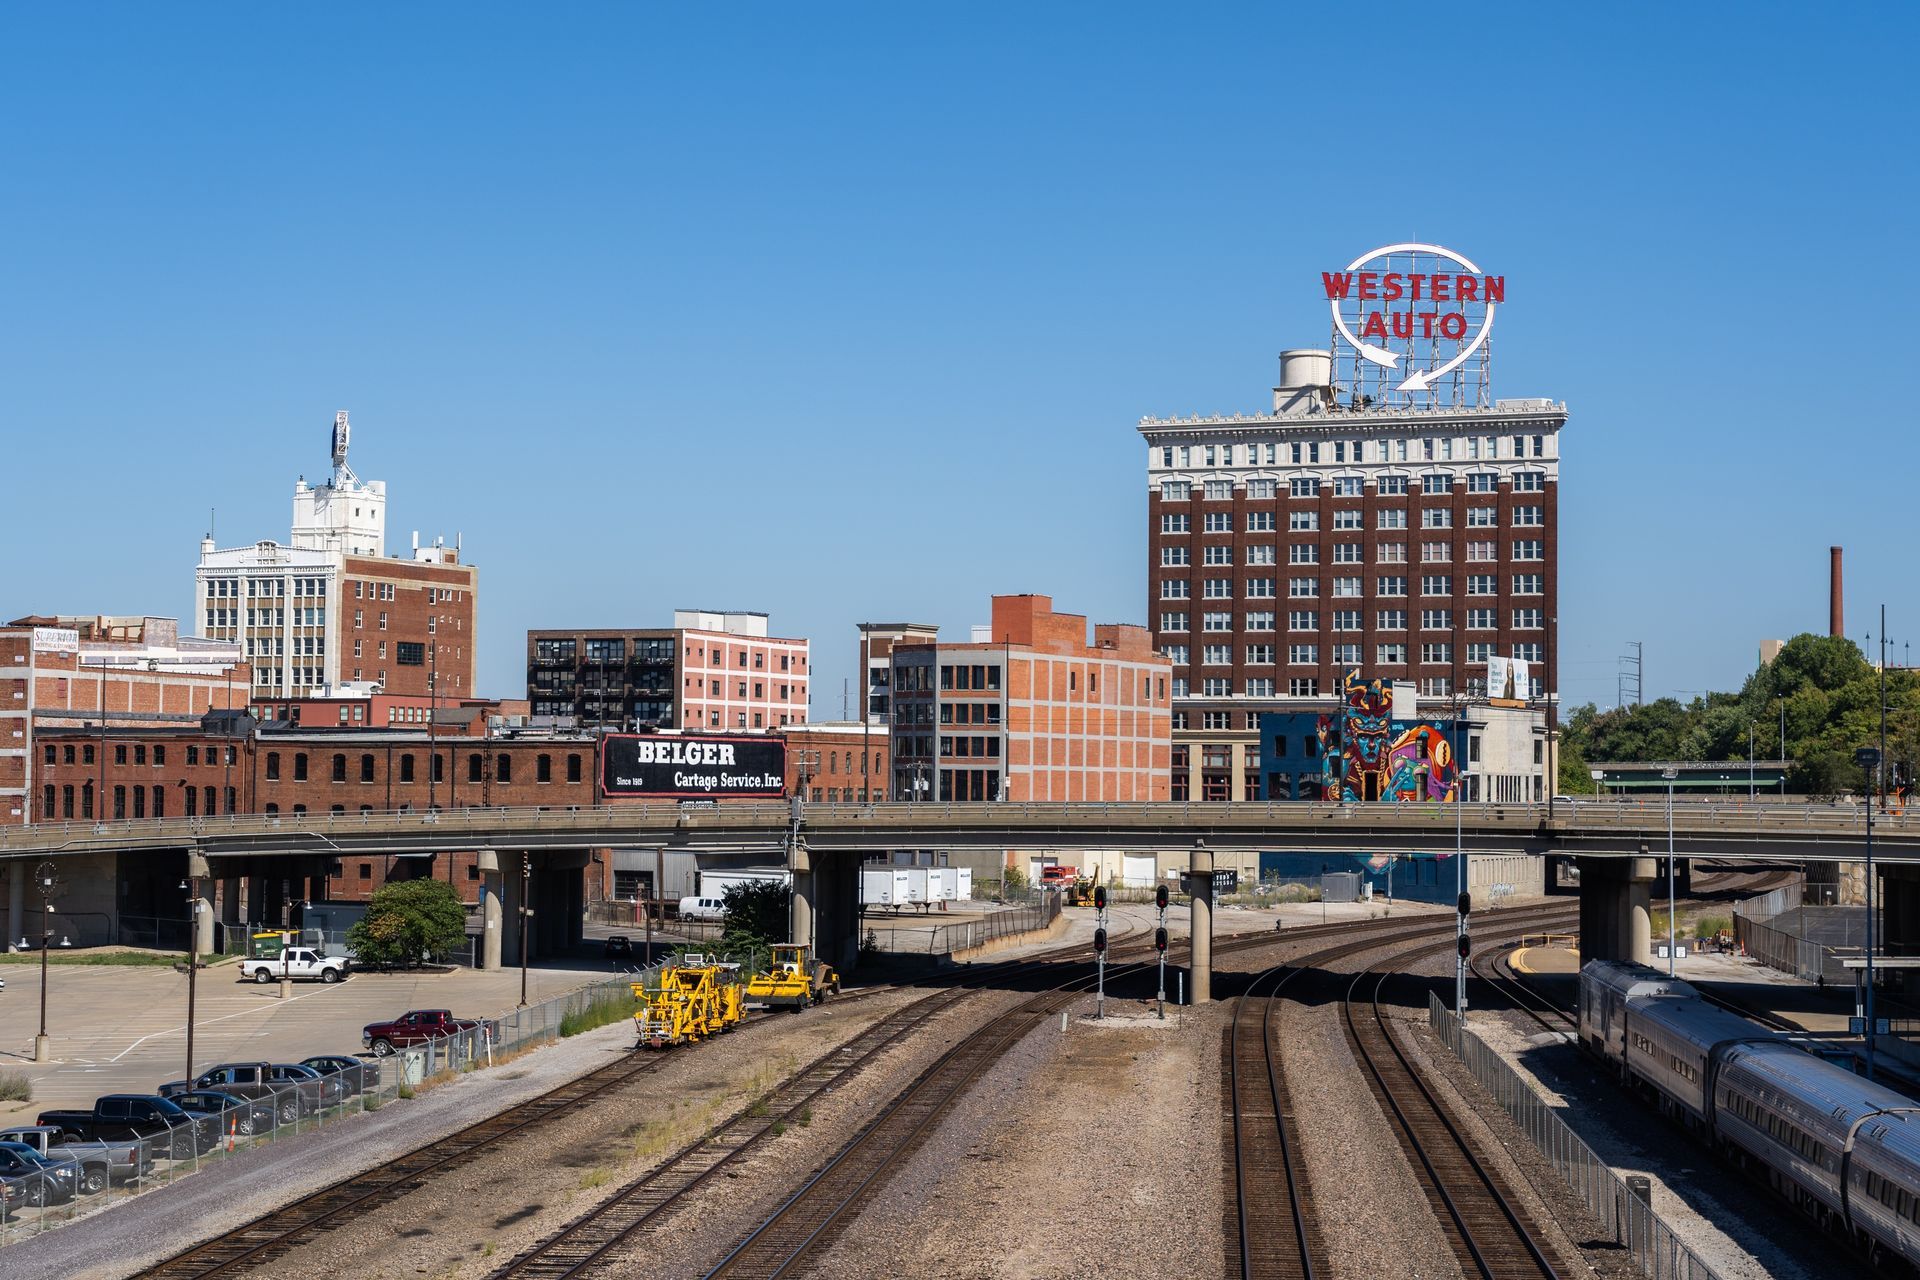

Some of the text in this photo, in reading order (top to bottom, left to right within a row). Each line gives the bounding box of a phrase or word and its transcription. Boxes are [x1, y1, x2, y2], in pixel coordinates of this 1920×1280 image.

[1321, 272, 1505, 303] WESTERN
[1363, 311, 1468, 340] AUTO
[35, 631, 78, 643] SUPERIOR
[638, 741, 736, 765] BELGER
[616, 777, 631, 786] Since
[674, 771, 718, 791] Cartage
